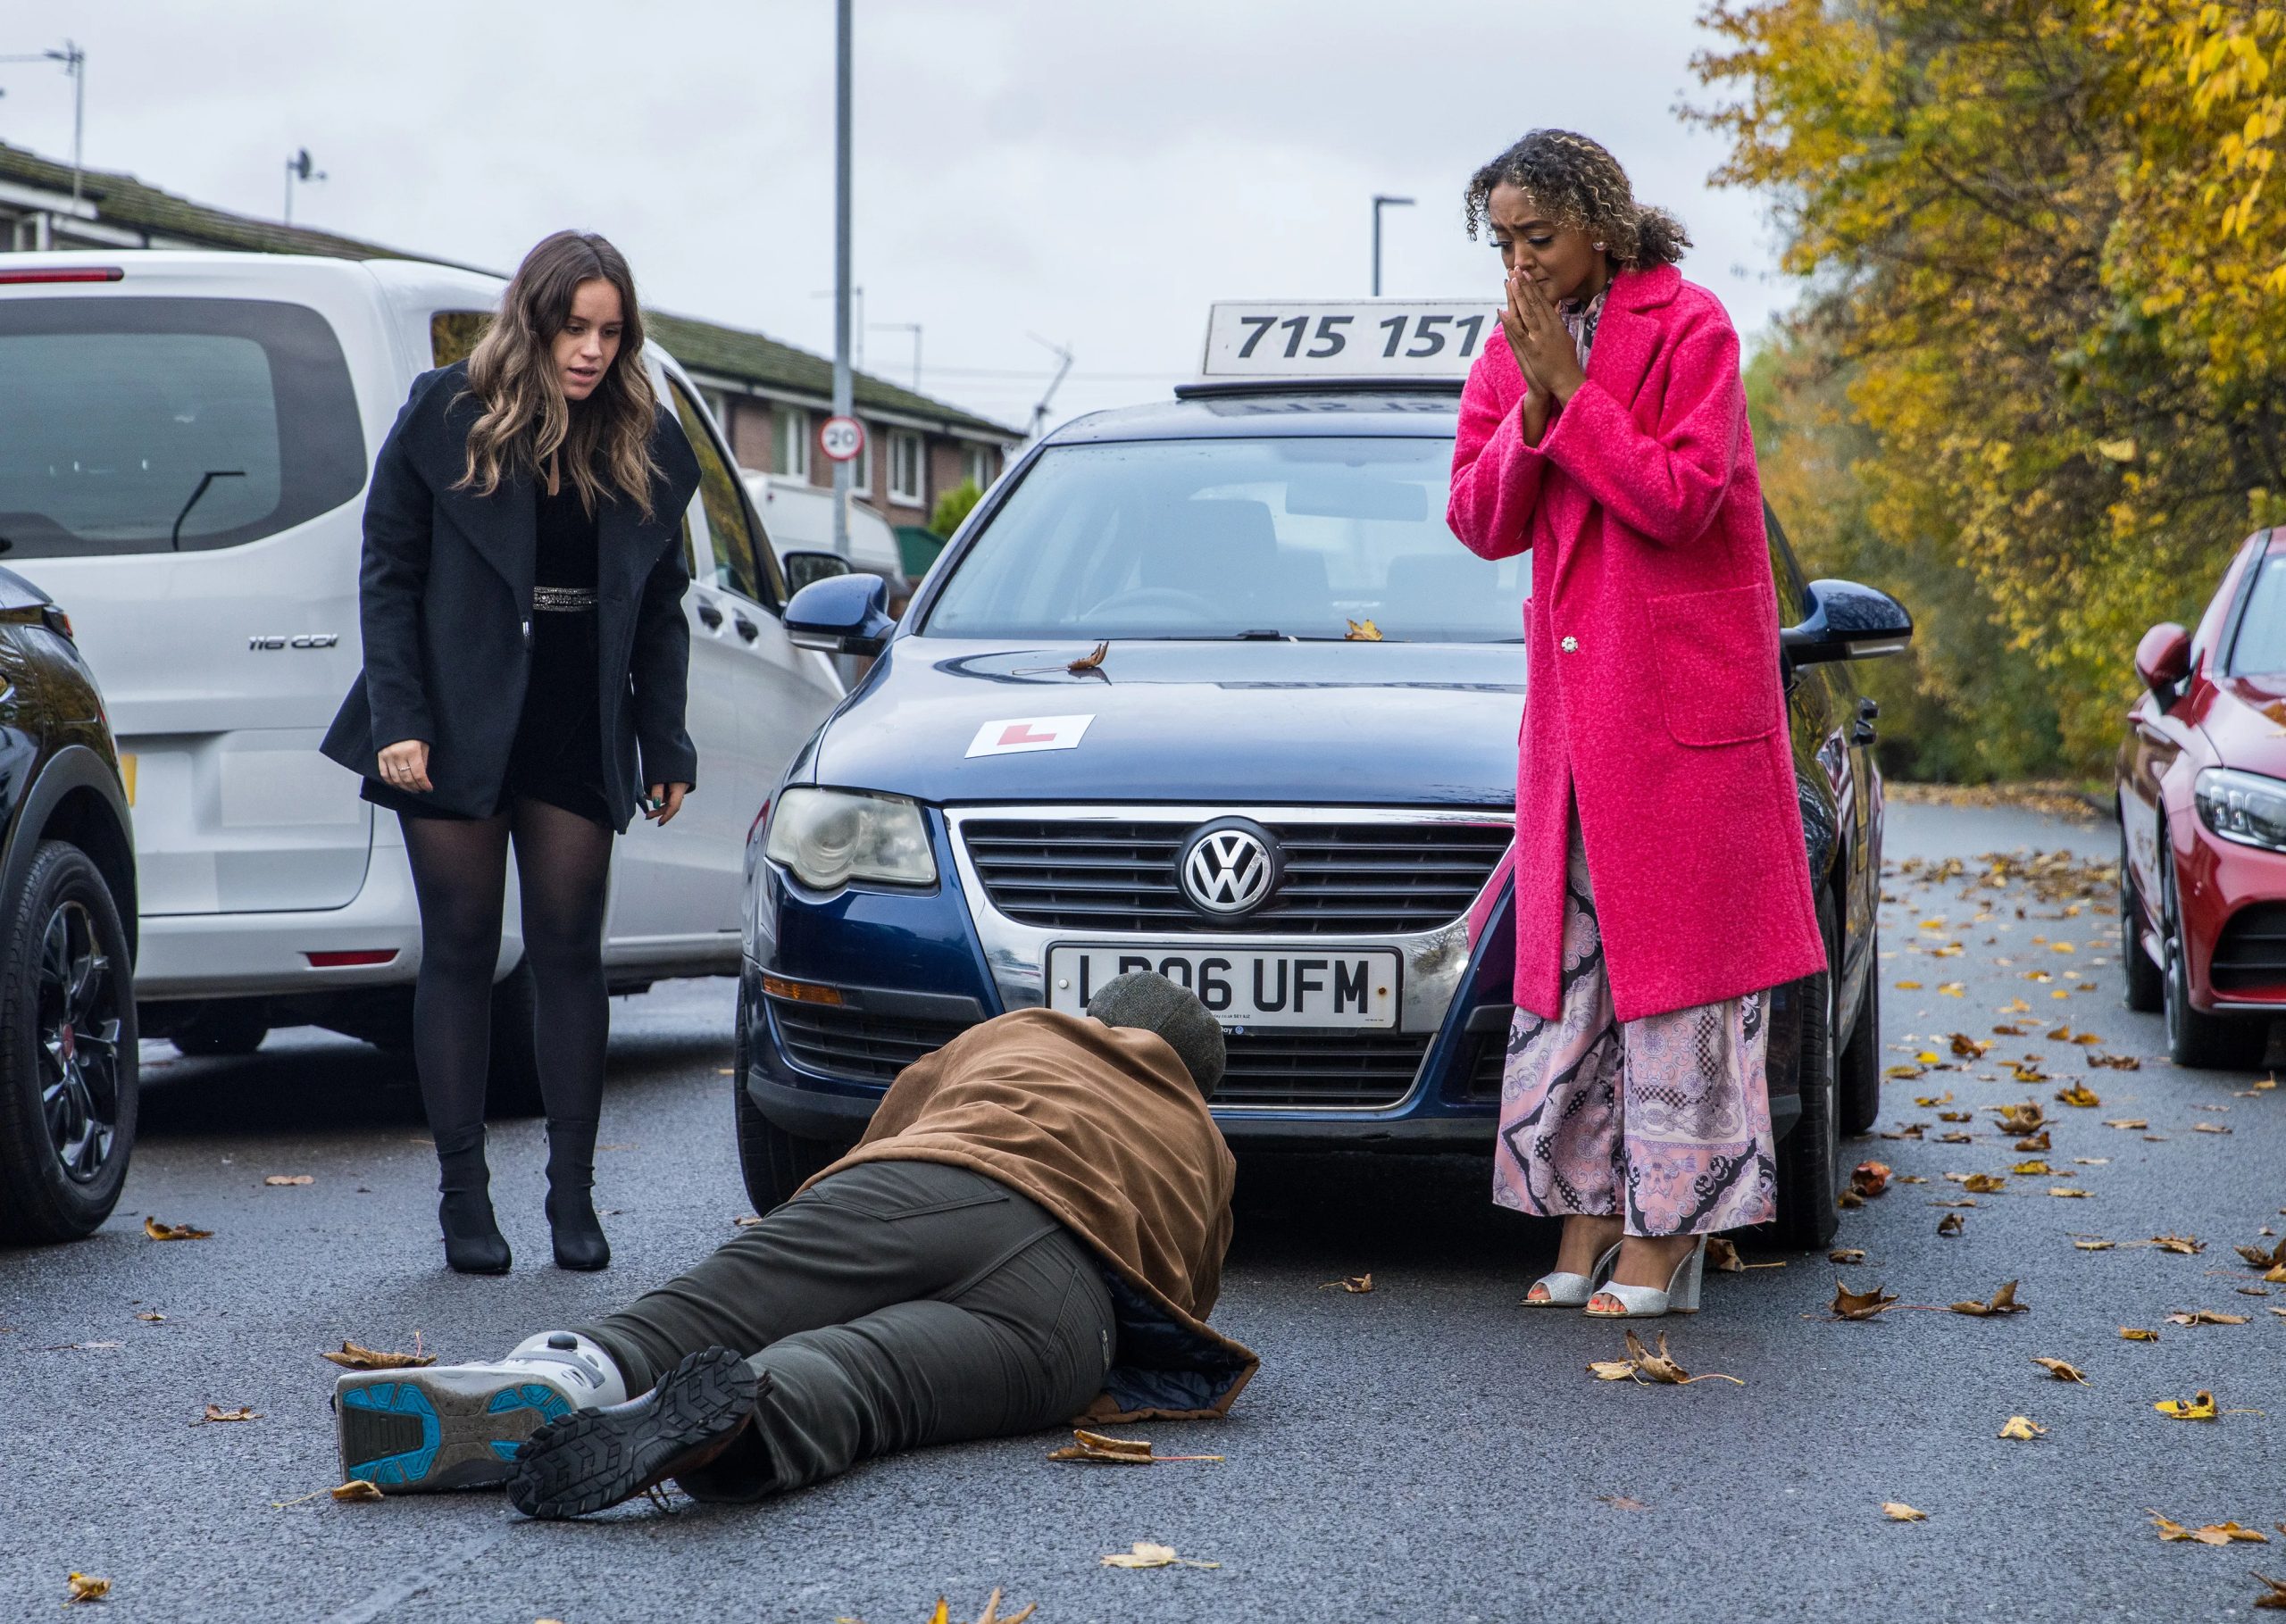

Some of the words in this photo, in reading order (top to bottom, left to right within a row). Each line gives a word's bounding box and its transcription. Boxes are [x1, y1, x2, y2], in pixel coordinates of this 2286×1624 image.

[1238, 315, 1355, 358] 715
[826, 429, 855, 447] 20
[997, 724, 1057, 745] L
[1253, 959, 1369, 1014] UFM
